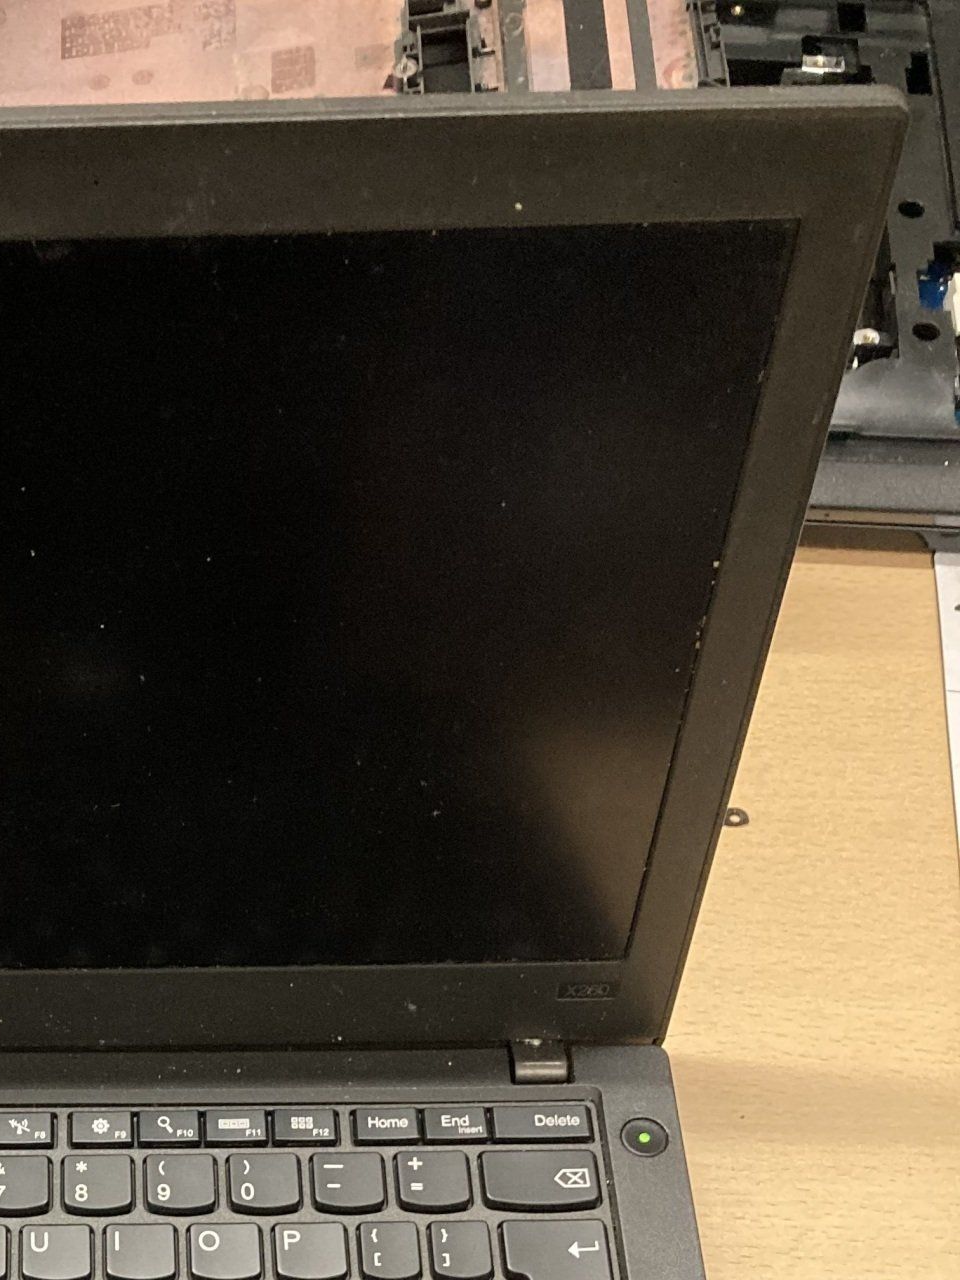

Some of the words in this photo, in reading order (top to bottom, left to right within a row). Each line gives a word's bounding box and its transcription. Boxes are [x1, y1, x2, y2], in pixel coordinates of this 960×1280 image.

[367, 1116, 409, 1129] Home
[440, 1114, 470, 1127] End
[534, 1114, 581, 1127] Delete
[34, 1130, 46, 1140] F8
[114, 1130, 127, 1139] F9
[176, 1128, 194, 1138] F10
[245, 1128, 261, 1137] F11
[312, 1127, 330, 1137] F12
[458, 1125, 483, 1134] Insert
[74, 1183, 89, 1202] 8
[157, 1183, 171, 1201] 9
[240, 1182, 255, 1201] 0
[30, 1231, 49, 1253] U
[114, 1230, 120, 1251] I
[198, 1230, 220, 1252] O
[283, 1230, 301, 1251] P
